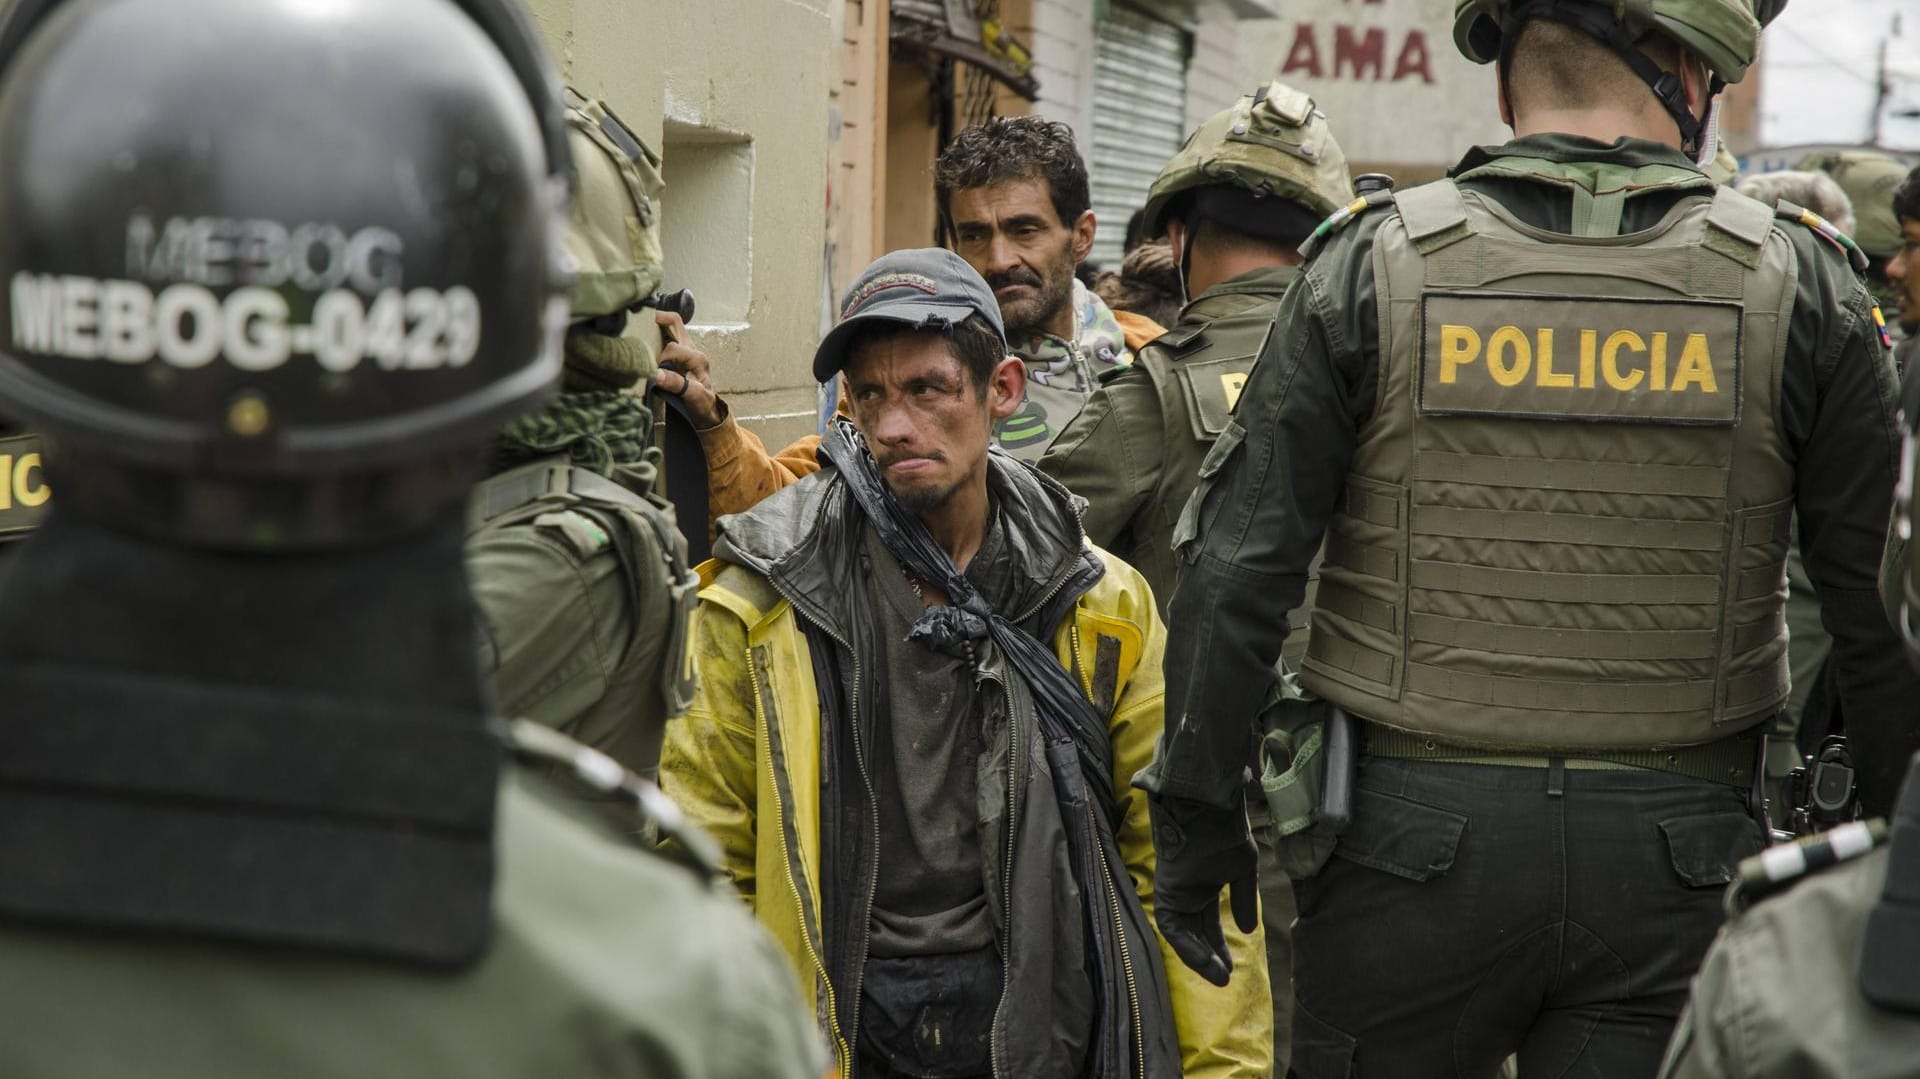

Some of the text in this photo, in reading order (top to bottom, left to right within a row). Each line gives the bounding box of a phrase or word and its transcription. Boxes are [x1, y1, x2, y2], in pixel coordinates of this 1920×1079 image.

[1281, 24, 1435, 84] AMA
[125, 212, 403, 296] MEBOG
[10, 269, 481, 371] MEBOG-0429
[1439, 324, 1718, 393] POLICIA
